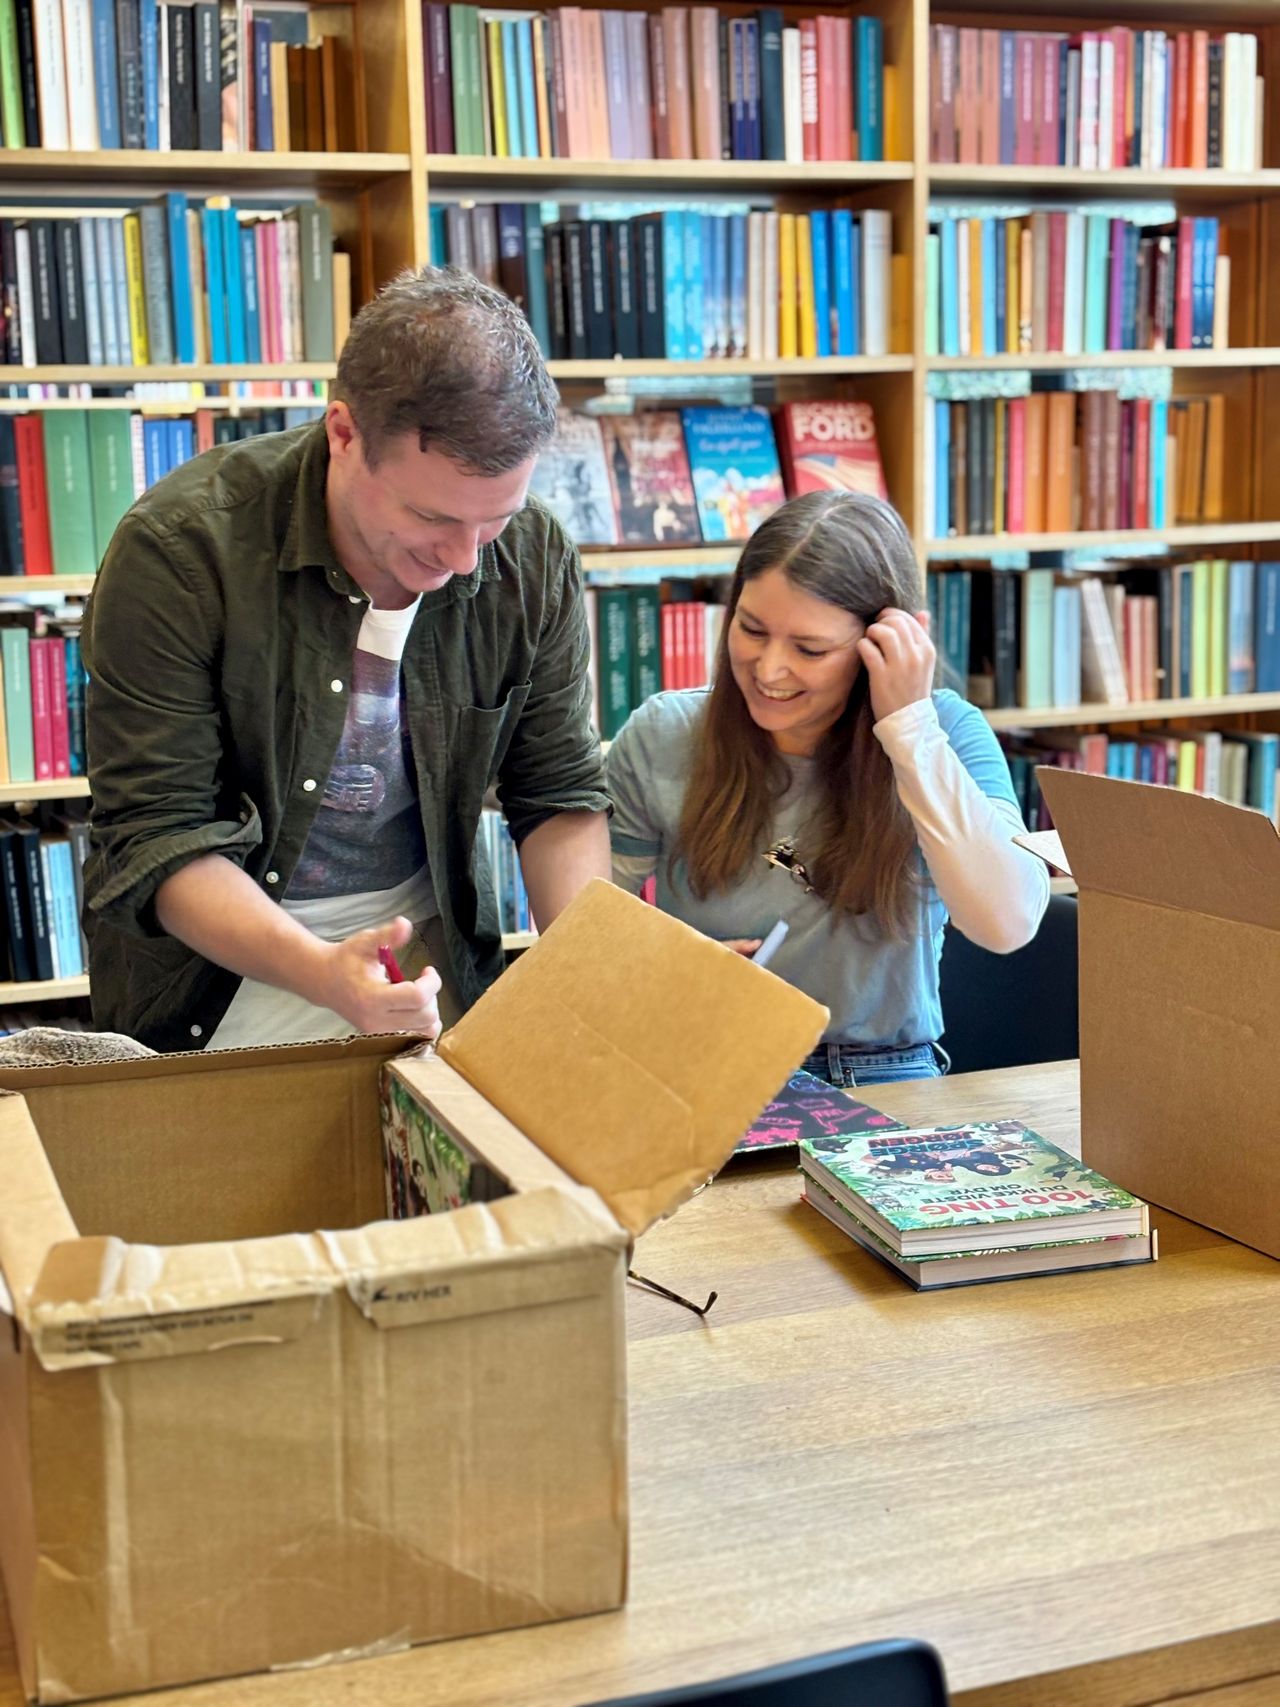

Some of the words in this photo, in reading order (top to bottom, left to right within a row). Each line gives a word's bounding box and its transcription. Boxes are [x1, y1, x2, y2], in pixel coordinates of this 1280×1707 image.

[794, 414, 876, 442] FORD
[867, 1130, 977, 1148] JØRGEN
[869, 1139, 986, 1157] SPØRGE
[949, 1185, 988, 1196] DYR
[989, 1183, 1022, 1193] OM
[992, 1187, 1038, 1199] IKKE
[1038, 1184, 1067, 1194] DU
[921, 1192, 992, 1205] VIDSTE
[1021, 1188, 1095, 1208] 100
[918, 1197, 1017, 1216] TING
